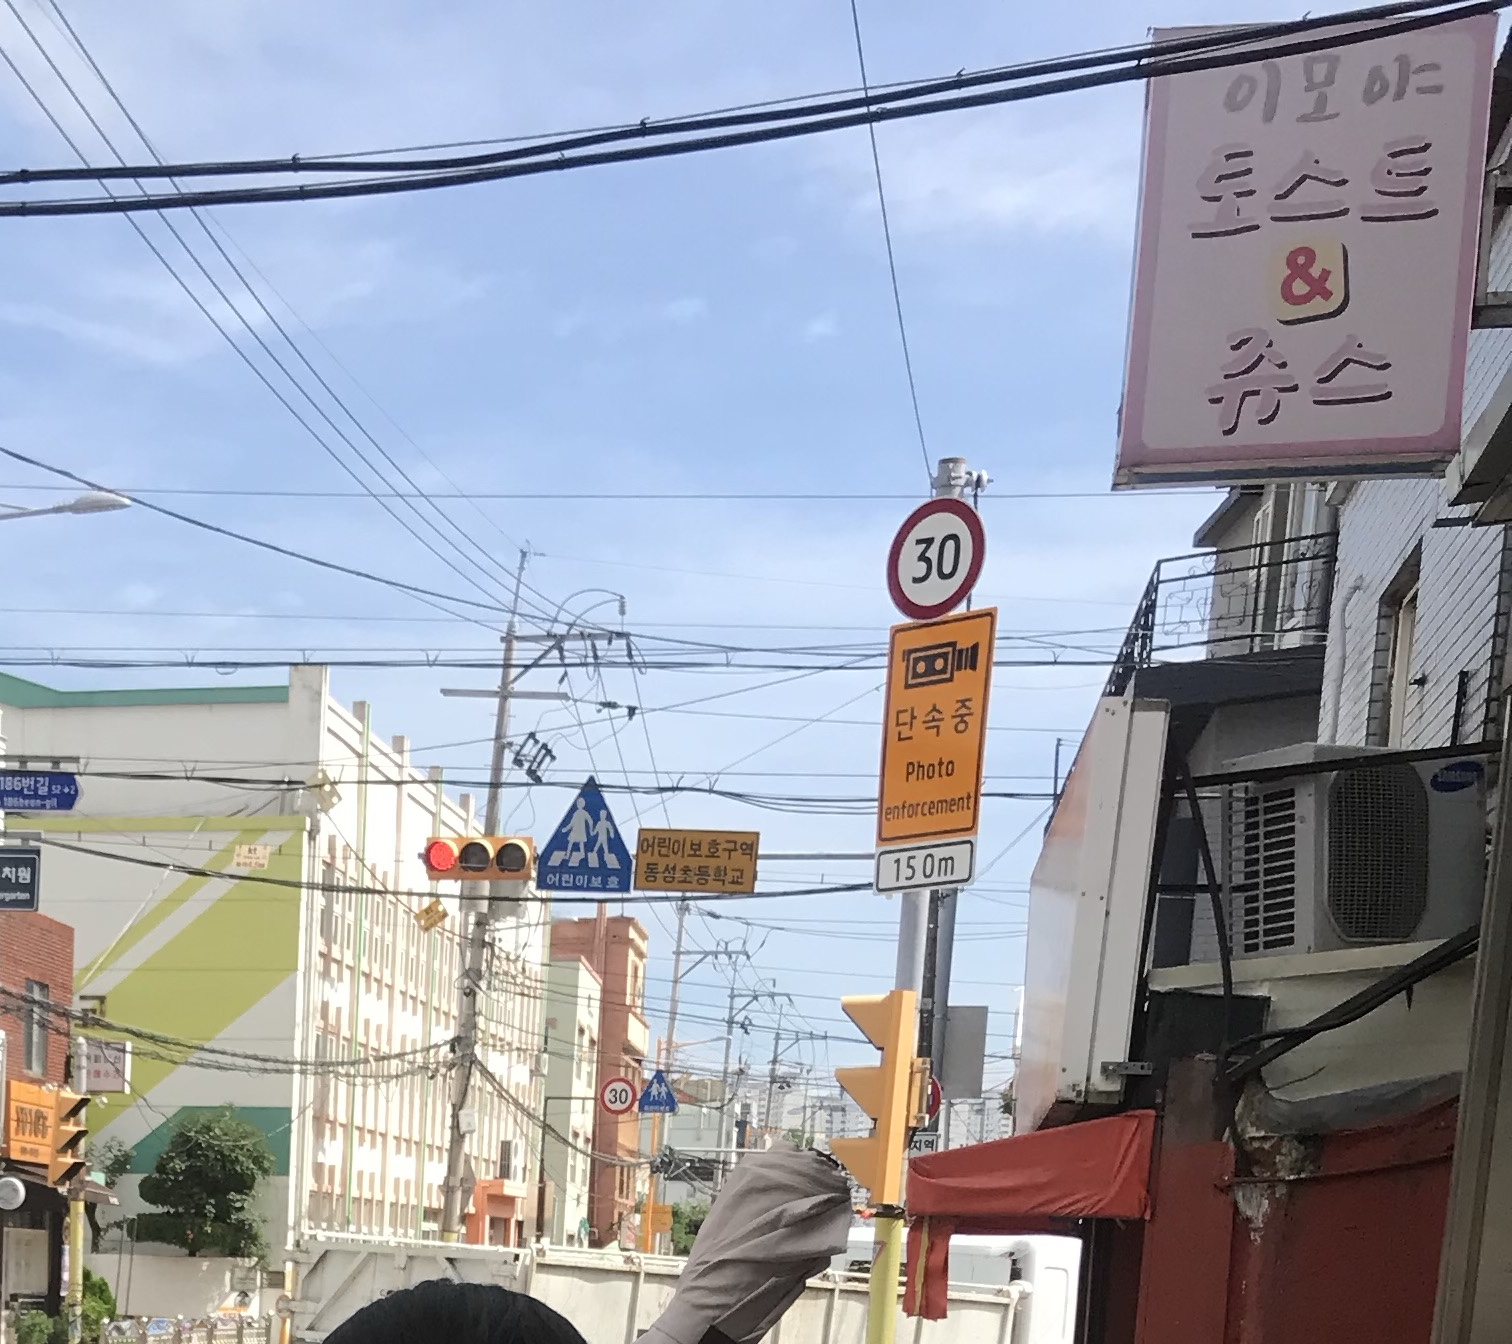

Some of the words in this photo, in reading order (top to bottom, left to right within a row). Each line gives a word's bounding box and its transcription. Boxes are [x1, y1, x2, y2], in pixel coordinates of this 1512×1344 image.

[1223, 54, 1444, 124] 이모야
[1187, 136, 1440, 239] 토스트
[1280, 246, 1333, 306] &
[1206, 328, 1393, 437] 쥬스
[911, 533, 961, 585] 30
[895, 697, 974, 742] 단속중
[905, 757, 955, 783] Photo
[885, 791, 972, 822] enforcement
[641, 836, 755, 861] 어린이보호구역
[546, 872, 620, 889] 어린이보호
[644, 863, 745, 886] 동성초등학교
[893, 853, 955, 883] 150m
[608, 1088, 629, 1105] 30
[910, 1138, 935, 1152] 지역
